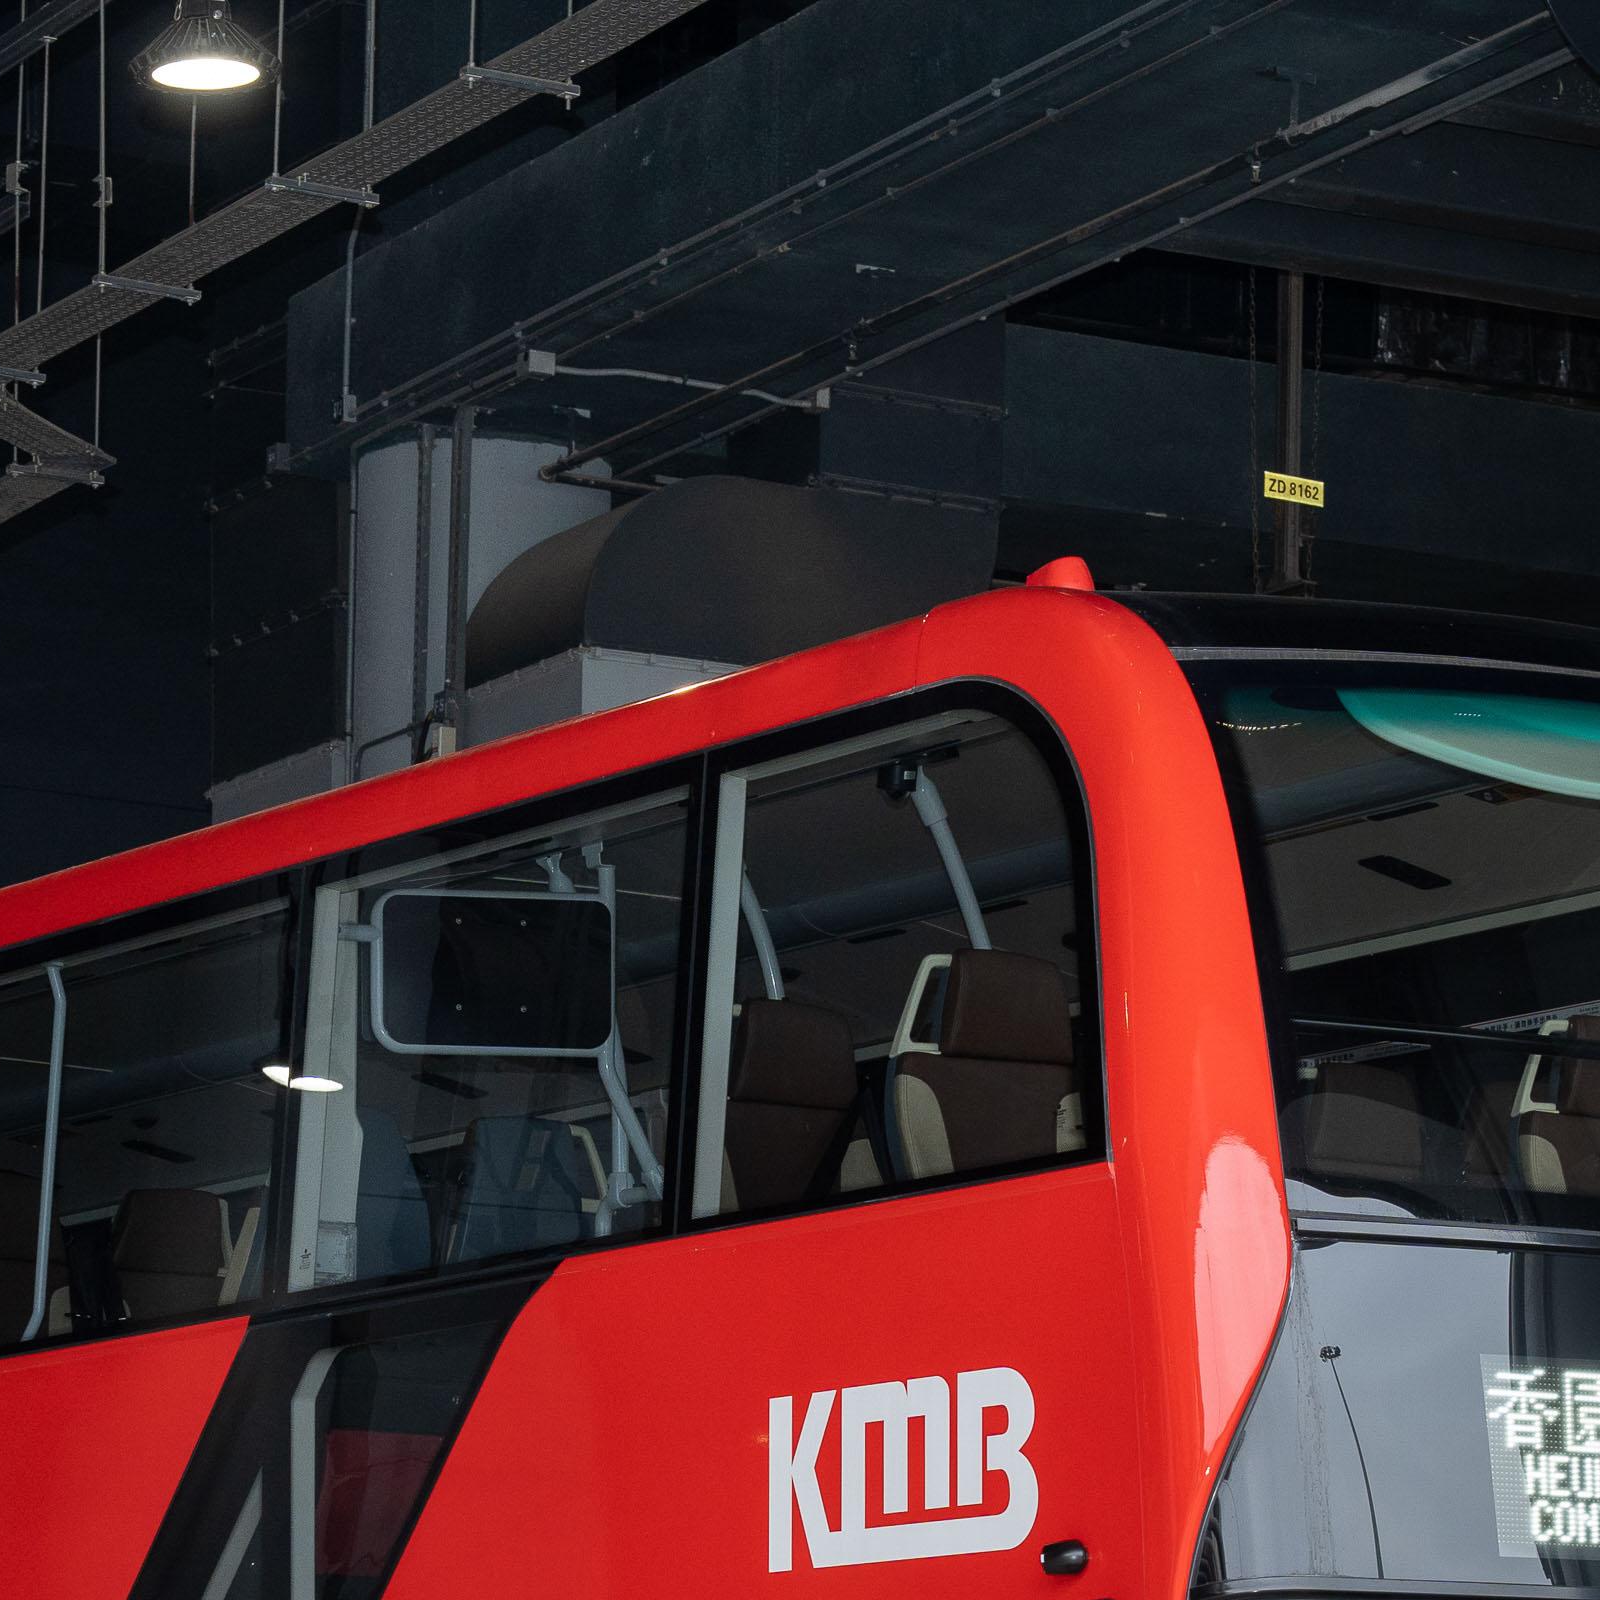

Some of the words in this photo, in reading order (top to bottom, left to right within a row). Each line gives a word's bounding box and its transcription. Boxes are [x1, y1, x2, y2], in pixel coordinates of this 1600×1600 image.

[1268, 478, 1286, 494] ZD
[1289, 482, 1319, 501] 8162
[768, 1366, 1040, 1574] KMB
